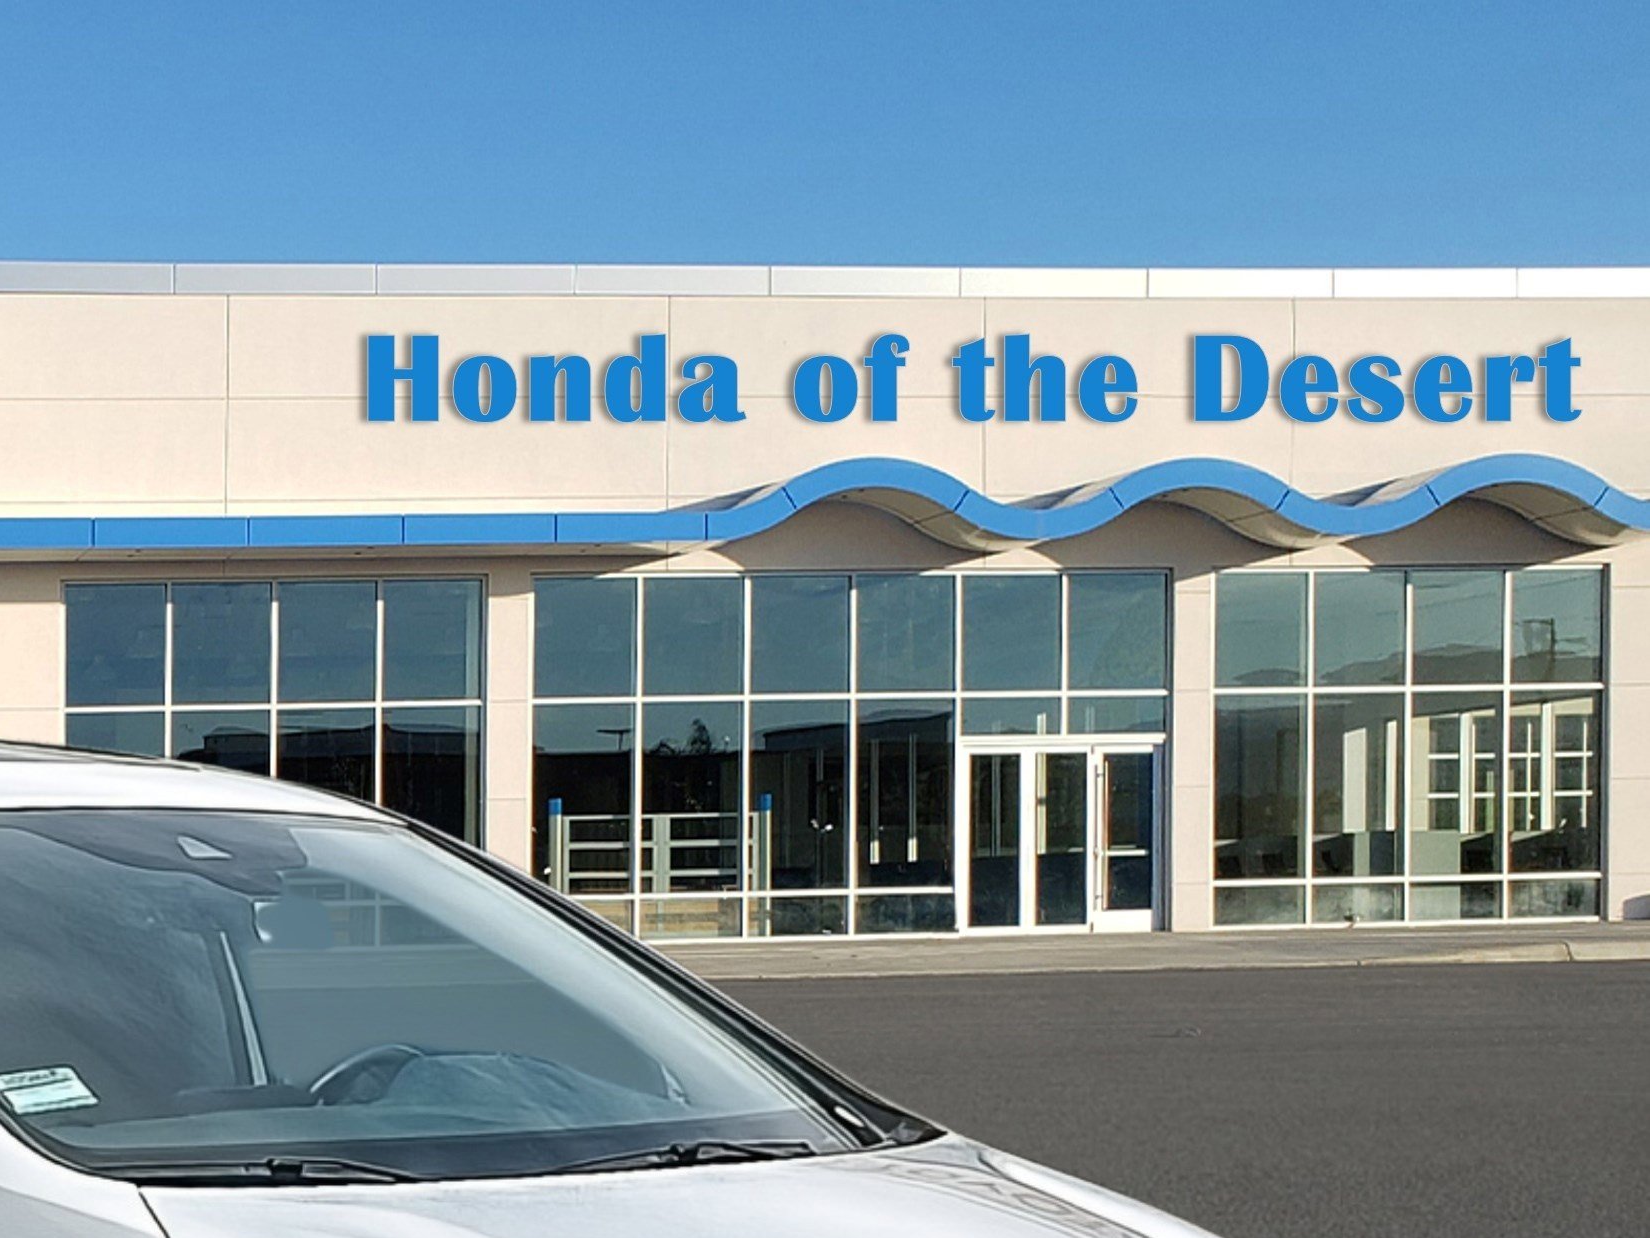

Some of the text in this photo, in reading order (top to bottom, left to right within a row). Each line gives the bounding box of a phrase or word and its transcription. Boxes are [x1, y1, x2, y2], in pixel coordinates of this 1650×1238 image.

[367, 333, 1583, 424] Honda of the Desert
